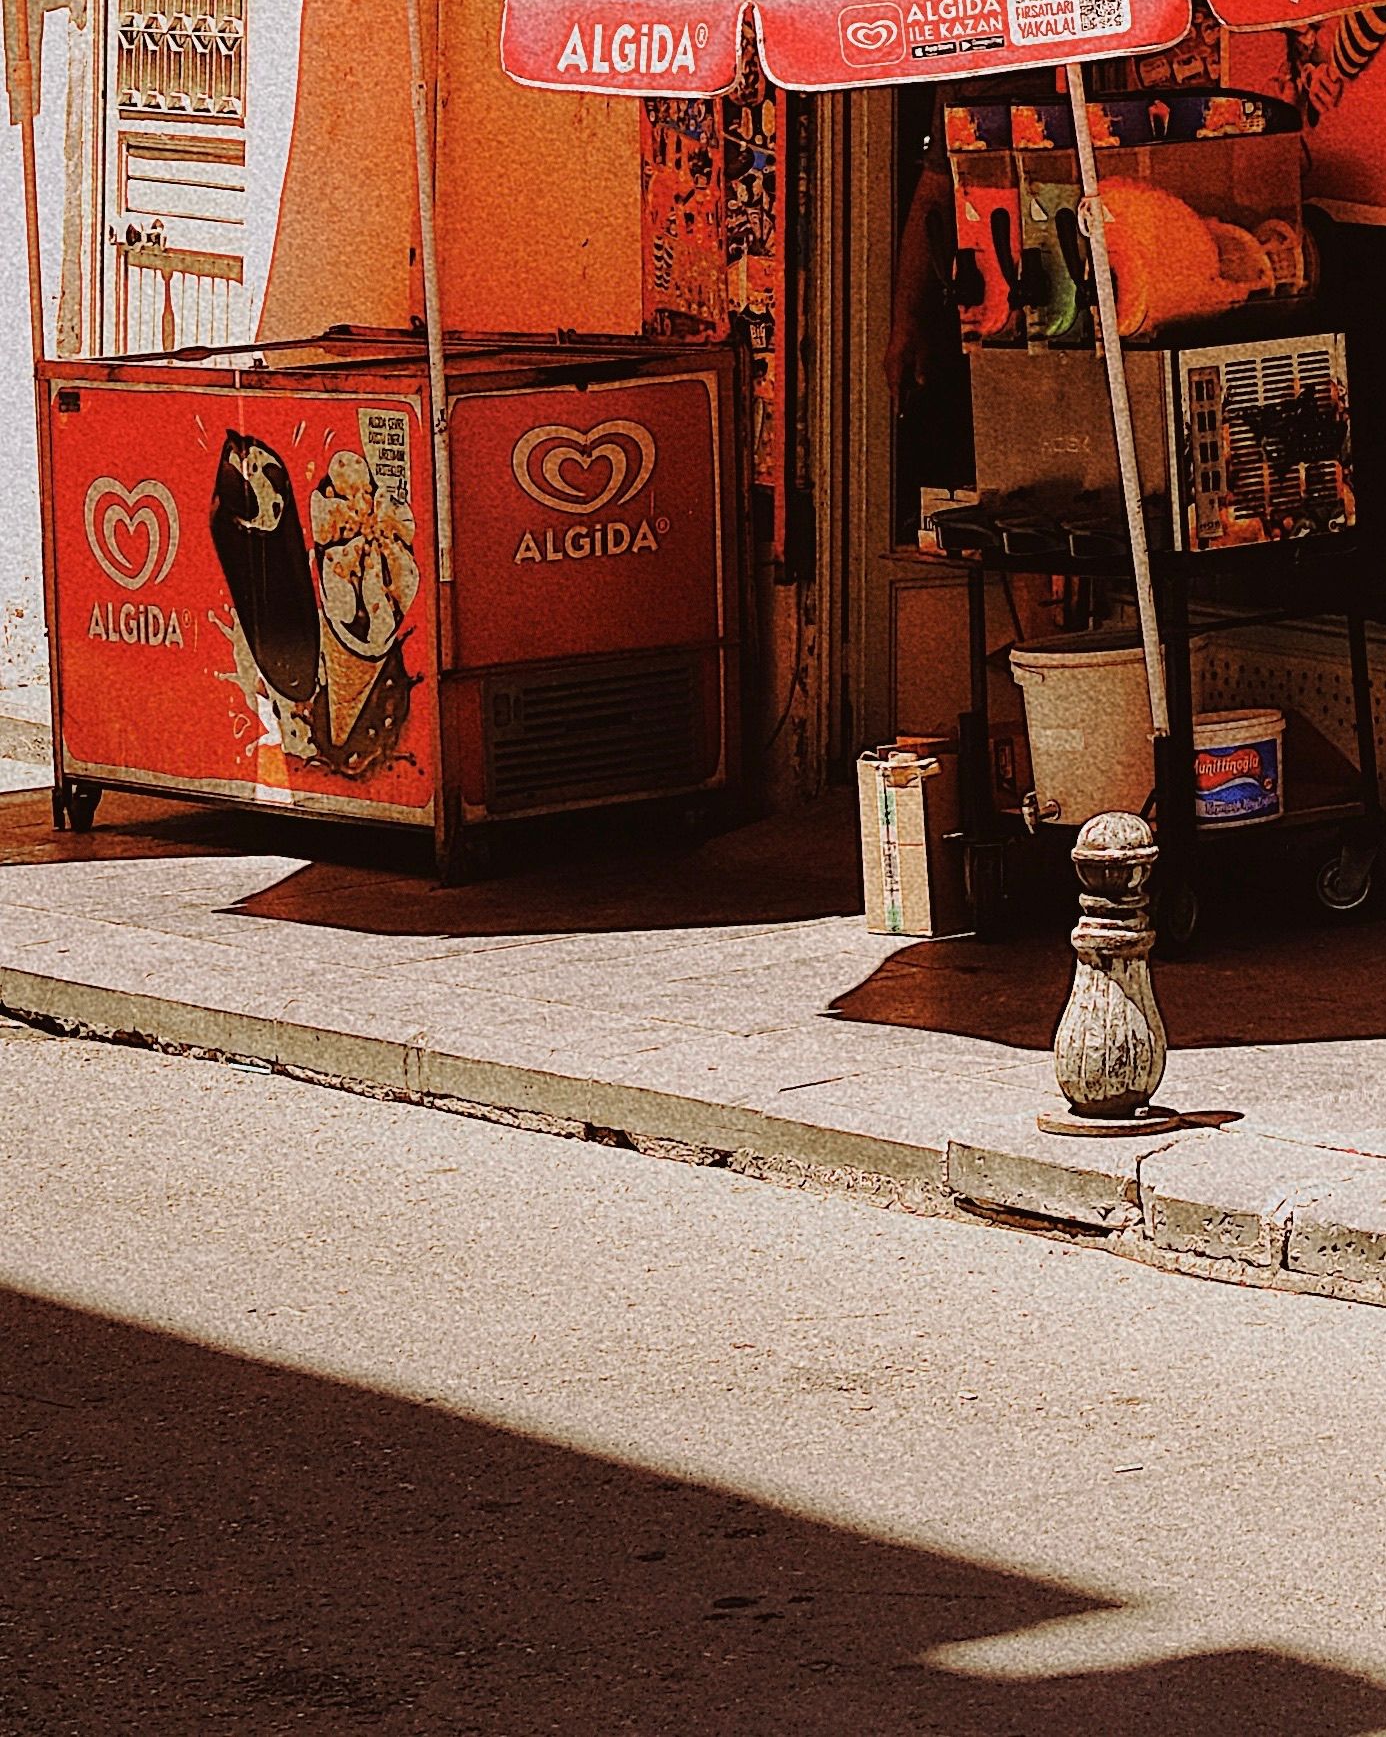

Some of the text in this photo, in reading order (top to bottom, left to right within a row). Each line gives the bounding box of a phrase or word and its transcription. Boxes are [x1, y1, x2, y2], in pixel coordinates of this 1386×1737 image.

[1015, 0, 1075, 22] FIRSATLARI
[940, 17, 1004, 38] KAZAN
[1017, 20, 1078, 40] YAKALA!
